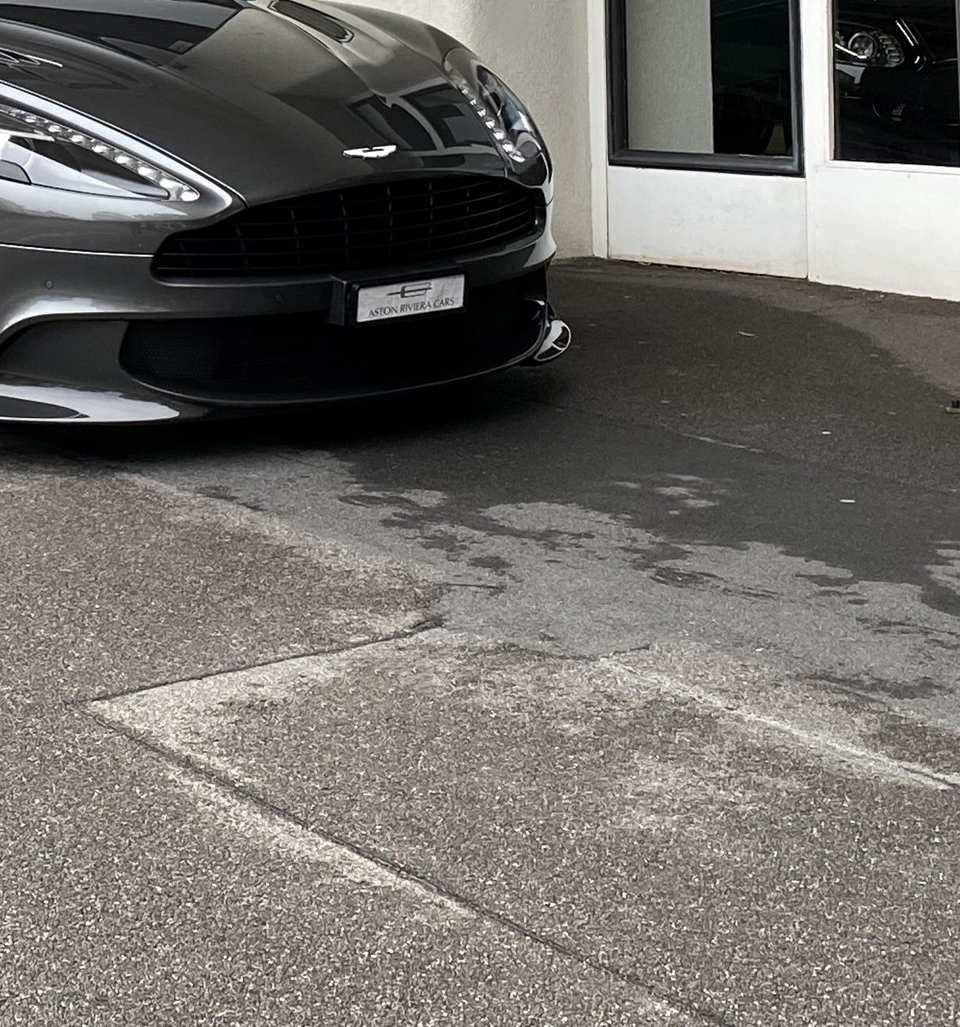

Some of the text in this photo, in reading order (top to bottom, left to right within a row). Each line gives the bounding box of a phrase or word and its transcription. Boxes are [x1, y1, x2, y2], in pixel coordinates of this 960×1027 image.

[368, 297, 455, 318] ASTON RIVIERA CARS
